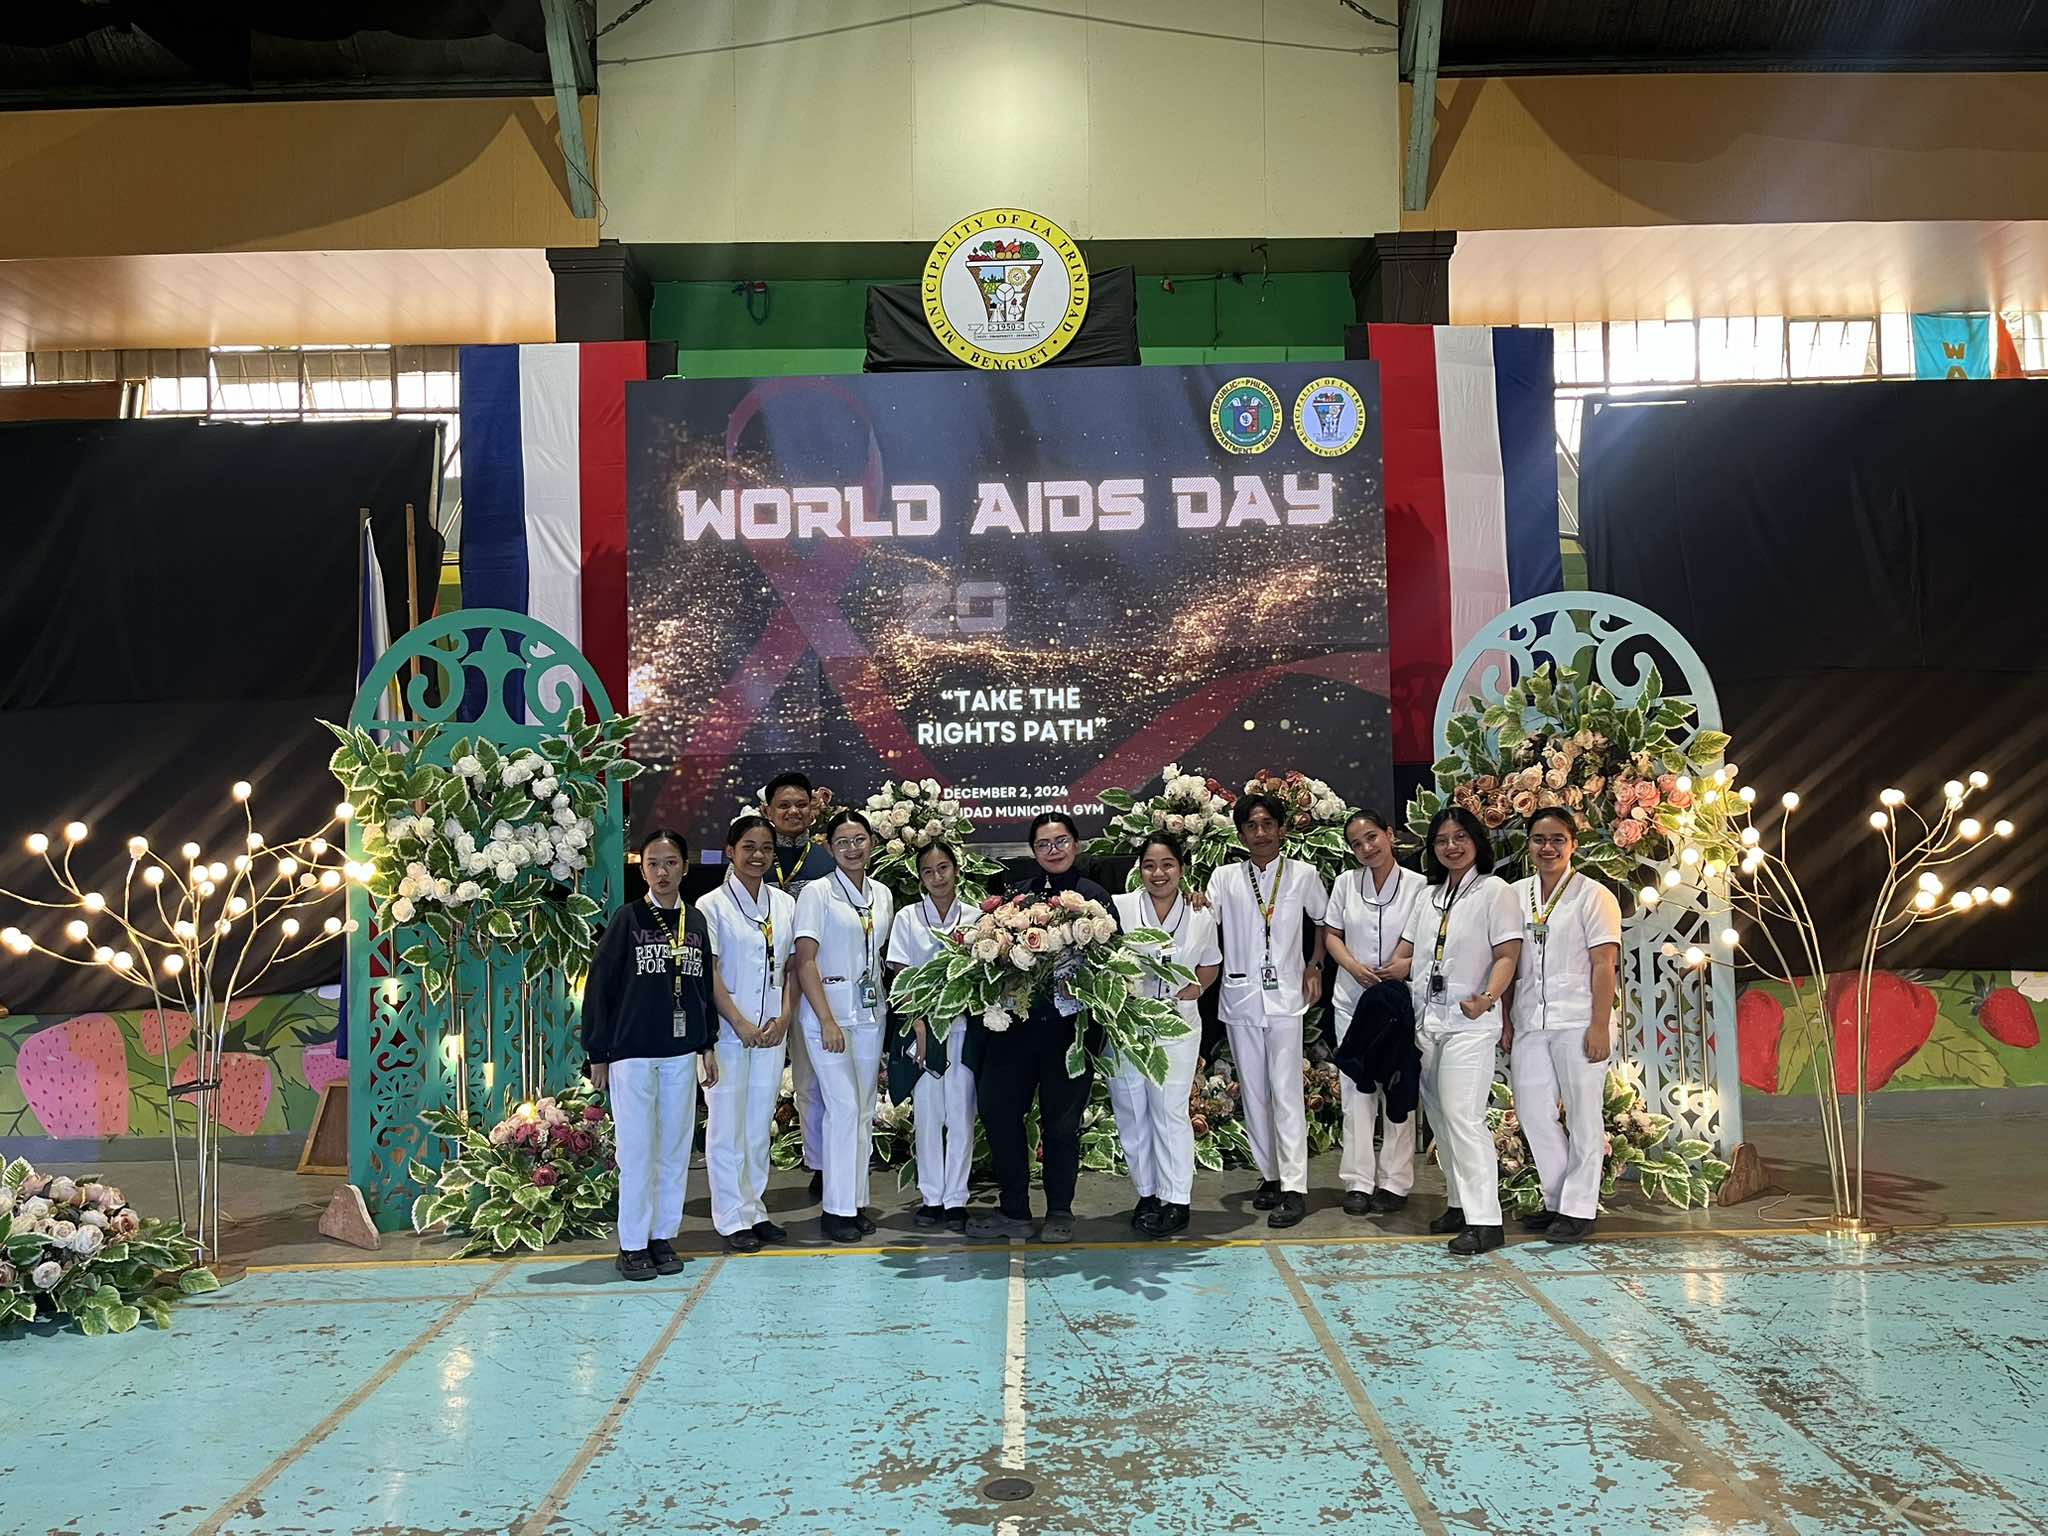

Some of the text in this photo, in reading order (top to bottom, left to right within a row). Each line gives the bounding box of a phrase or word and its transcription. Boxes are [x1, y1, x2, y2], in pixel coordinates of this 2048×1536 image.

[926, 213, 1085, 344] MUNICIPALITY OF LA TRINIDAD
[997, 322, 1016, 331] 1950
[970, 346, 1049, 371] BENGUET
[1212, 379, 1280, 414] REPUBLIC PHILIPPINES
[1295, 382, 1320, 443] MUNICIPALITY
[1339, 382, 1349, 392] LA
[1351, 393, 1364, 439] TRINIDAD
[1212, 419, 1280, 454] DEPARTMENT HEALTH
[678, 473, 1334, 541] WORLD AIDS DAY
[941, 687, 1081, 712] “TAKE THE
[917, 717, 1107, 745] RIGHTS PATH”
[943, 785, 1069, 800] DECEMBER 2, 2024
[960, 803, 1104, 818] IDAD MUNICIPAL GYM
[636, 958, 666, 975] FOR
